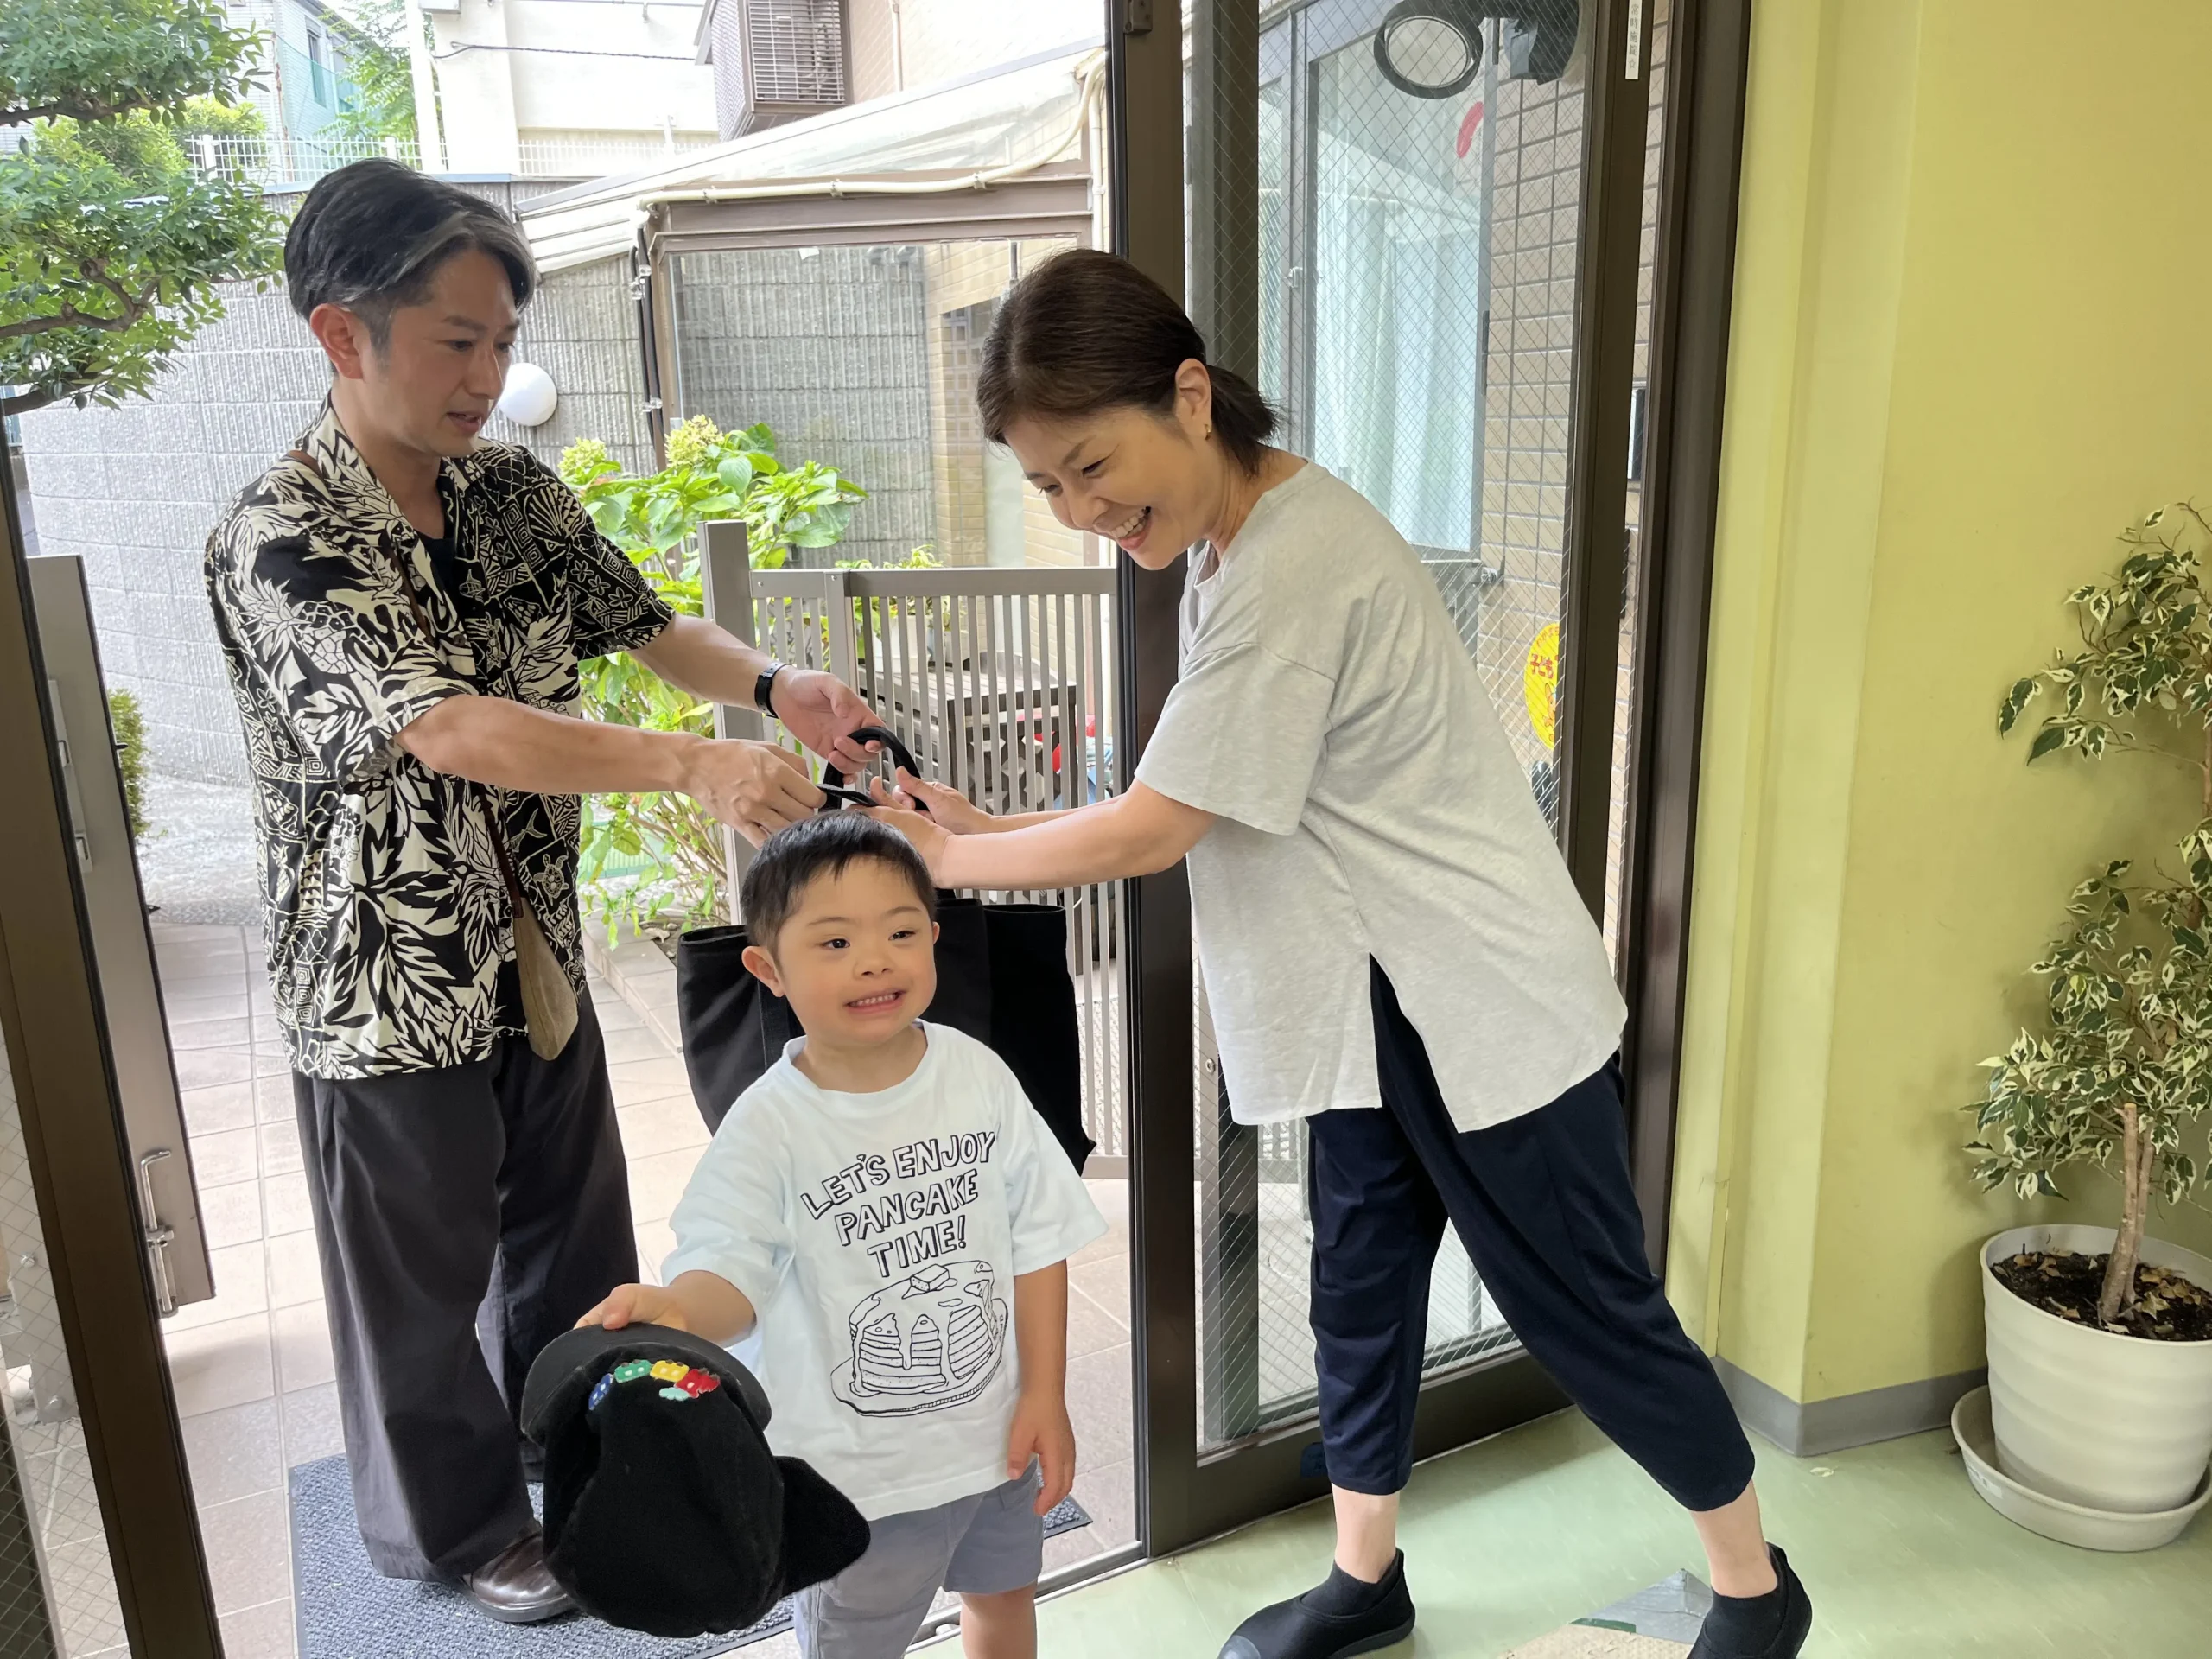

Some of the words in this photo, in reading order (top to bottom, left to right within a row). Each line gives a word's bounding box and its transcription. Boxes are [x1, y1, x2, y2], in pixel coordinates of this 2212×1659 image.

[800, 1154, 891, 1220] LET'S
[892, 1131, 996, 1179] ENJOY
[834, 1168, 978, 1247] PANCAKE
[867, 1215, 967, 1277] TIME!
